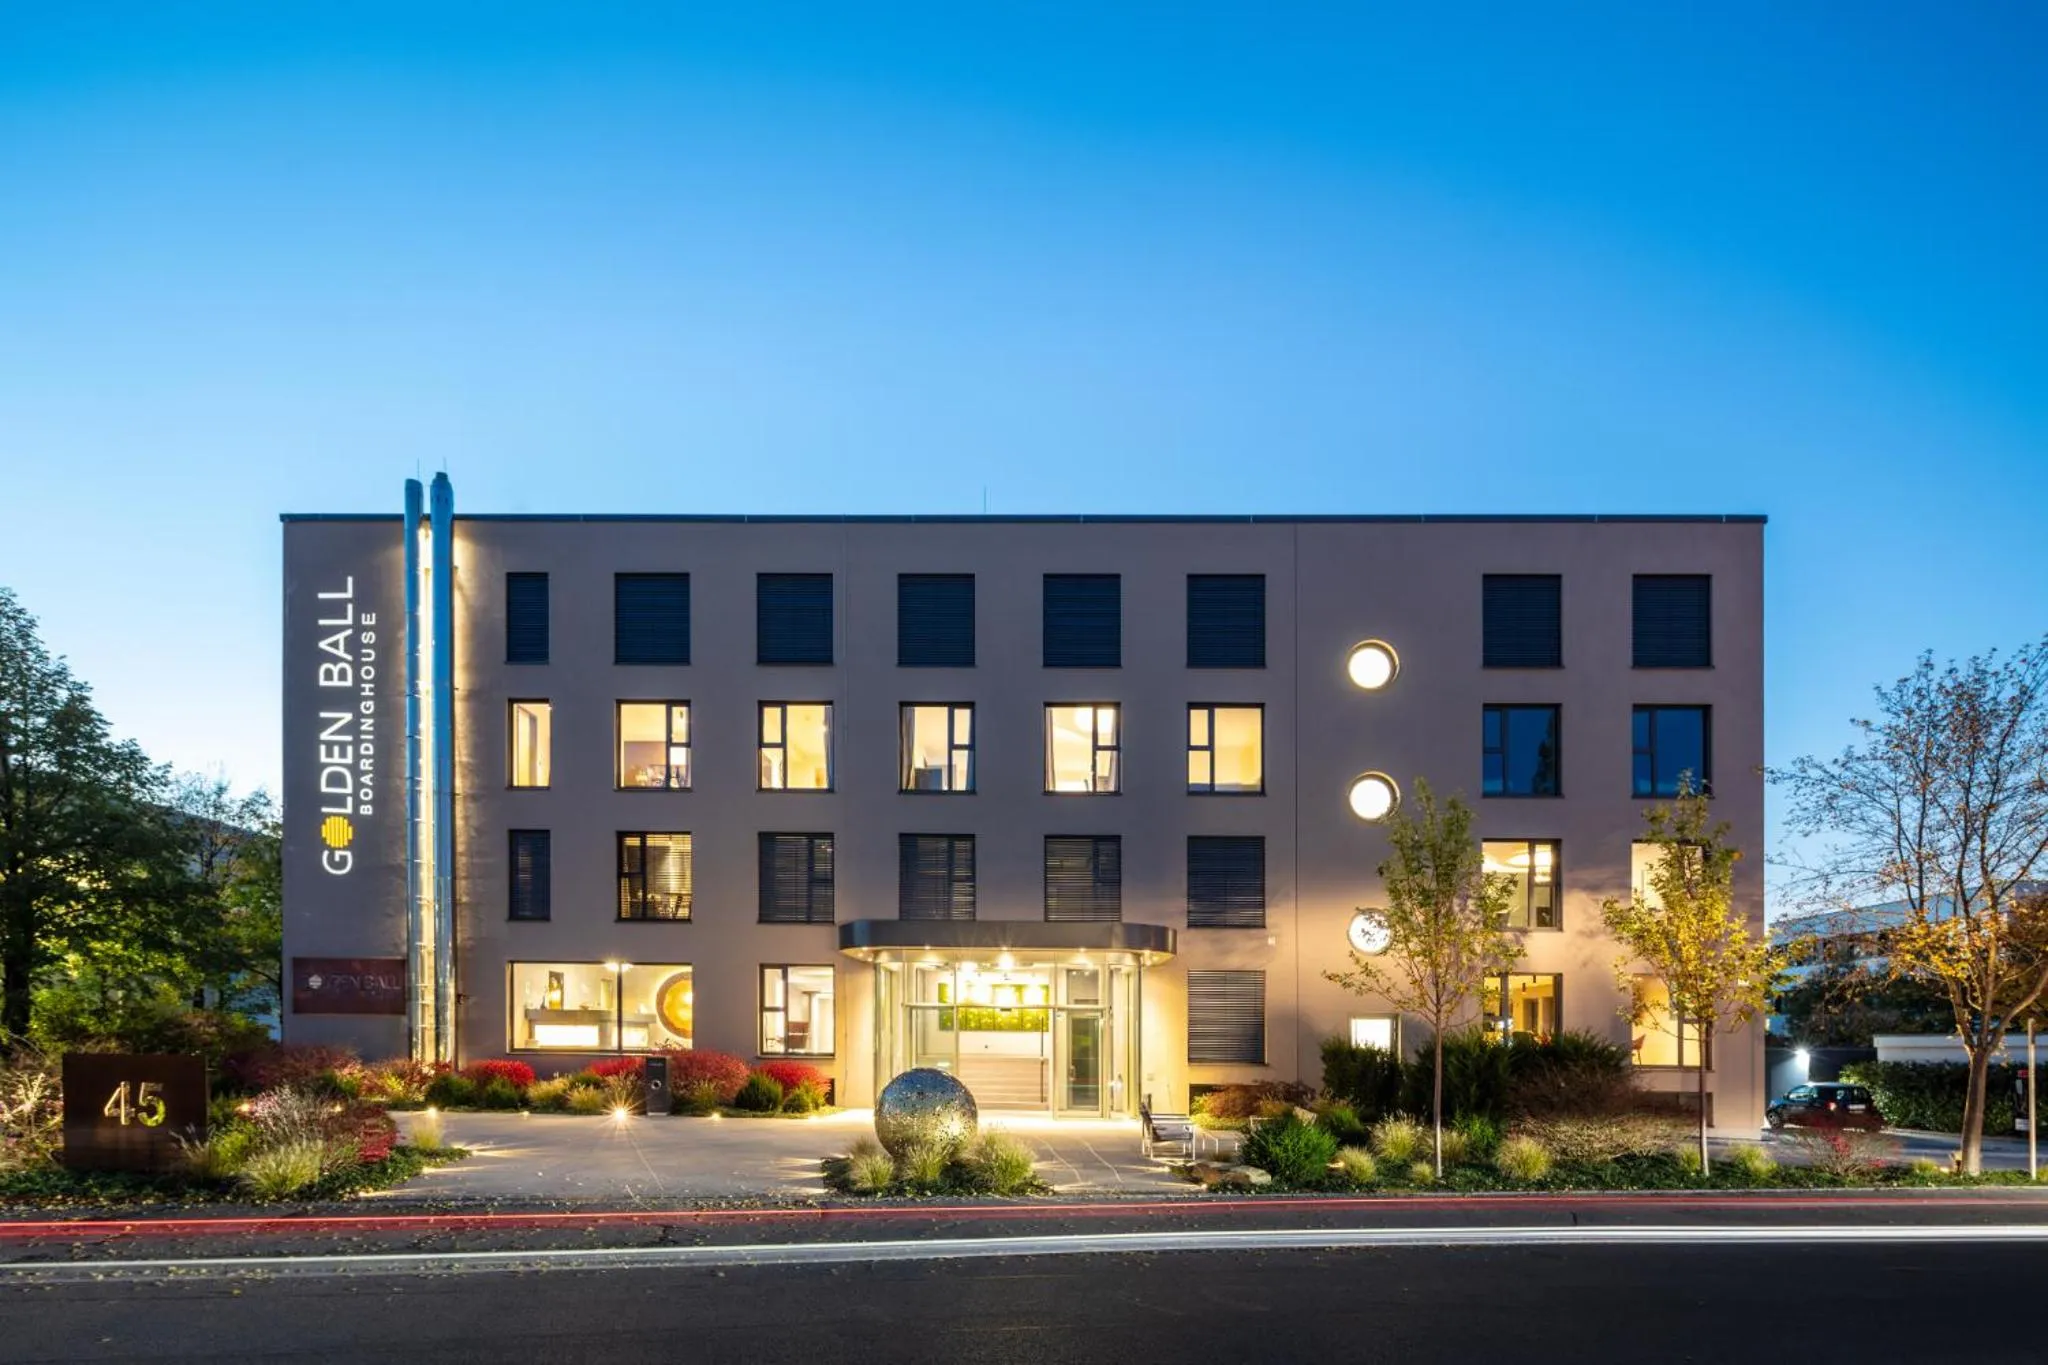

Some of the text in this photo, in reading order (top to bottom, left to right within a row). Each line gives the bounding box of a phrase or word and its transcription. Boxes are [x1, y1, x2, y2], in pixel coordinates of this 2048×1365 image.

[317, 576, 353, 875] GOLDEN BALL
[360, 612, 376, 815] BOARDINGHOUSE
[103, 1080, 167, 1127] 45
